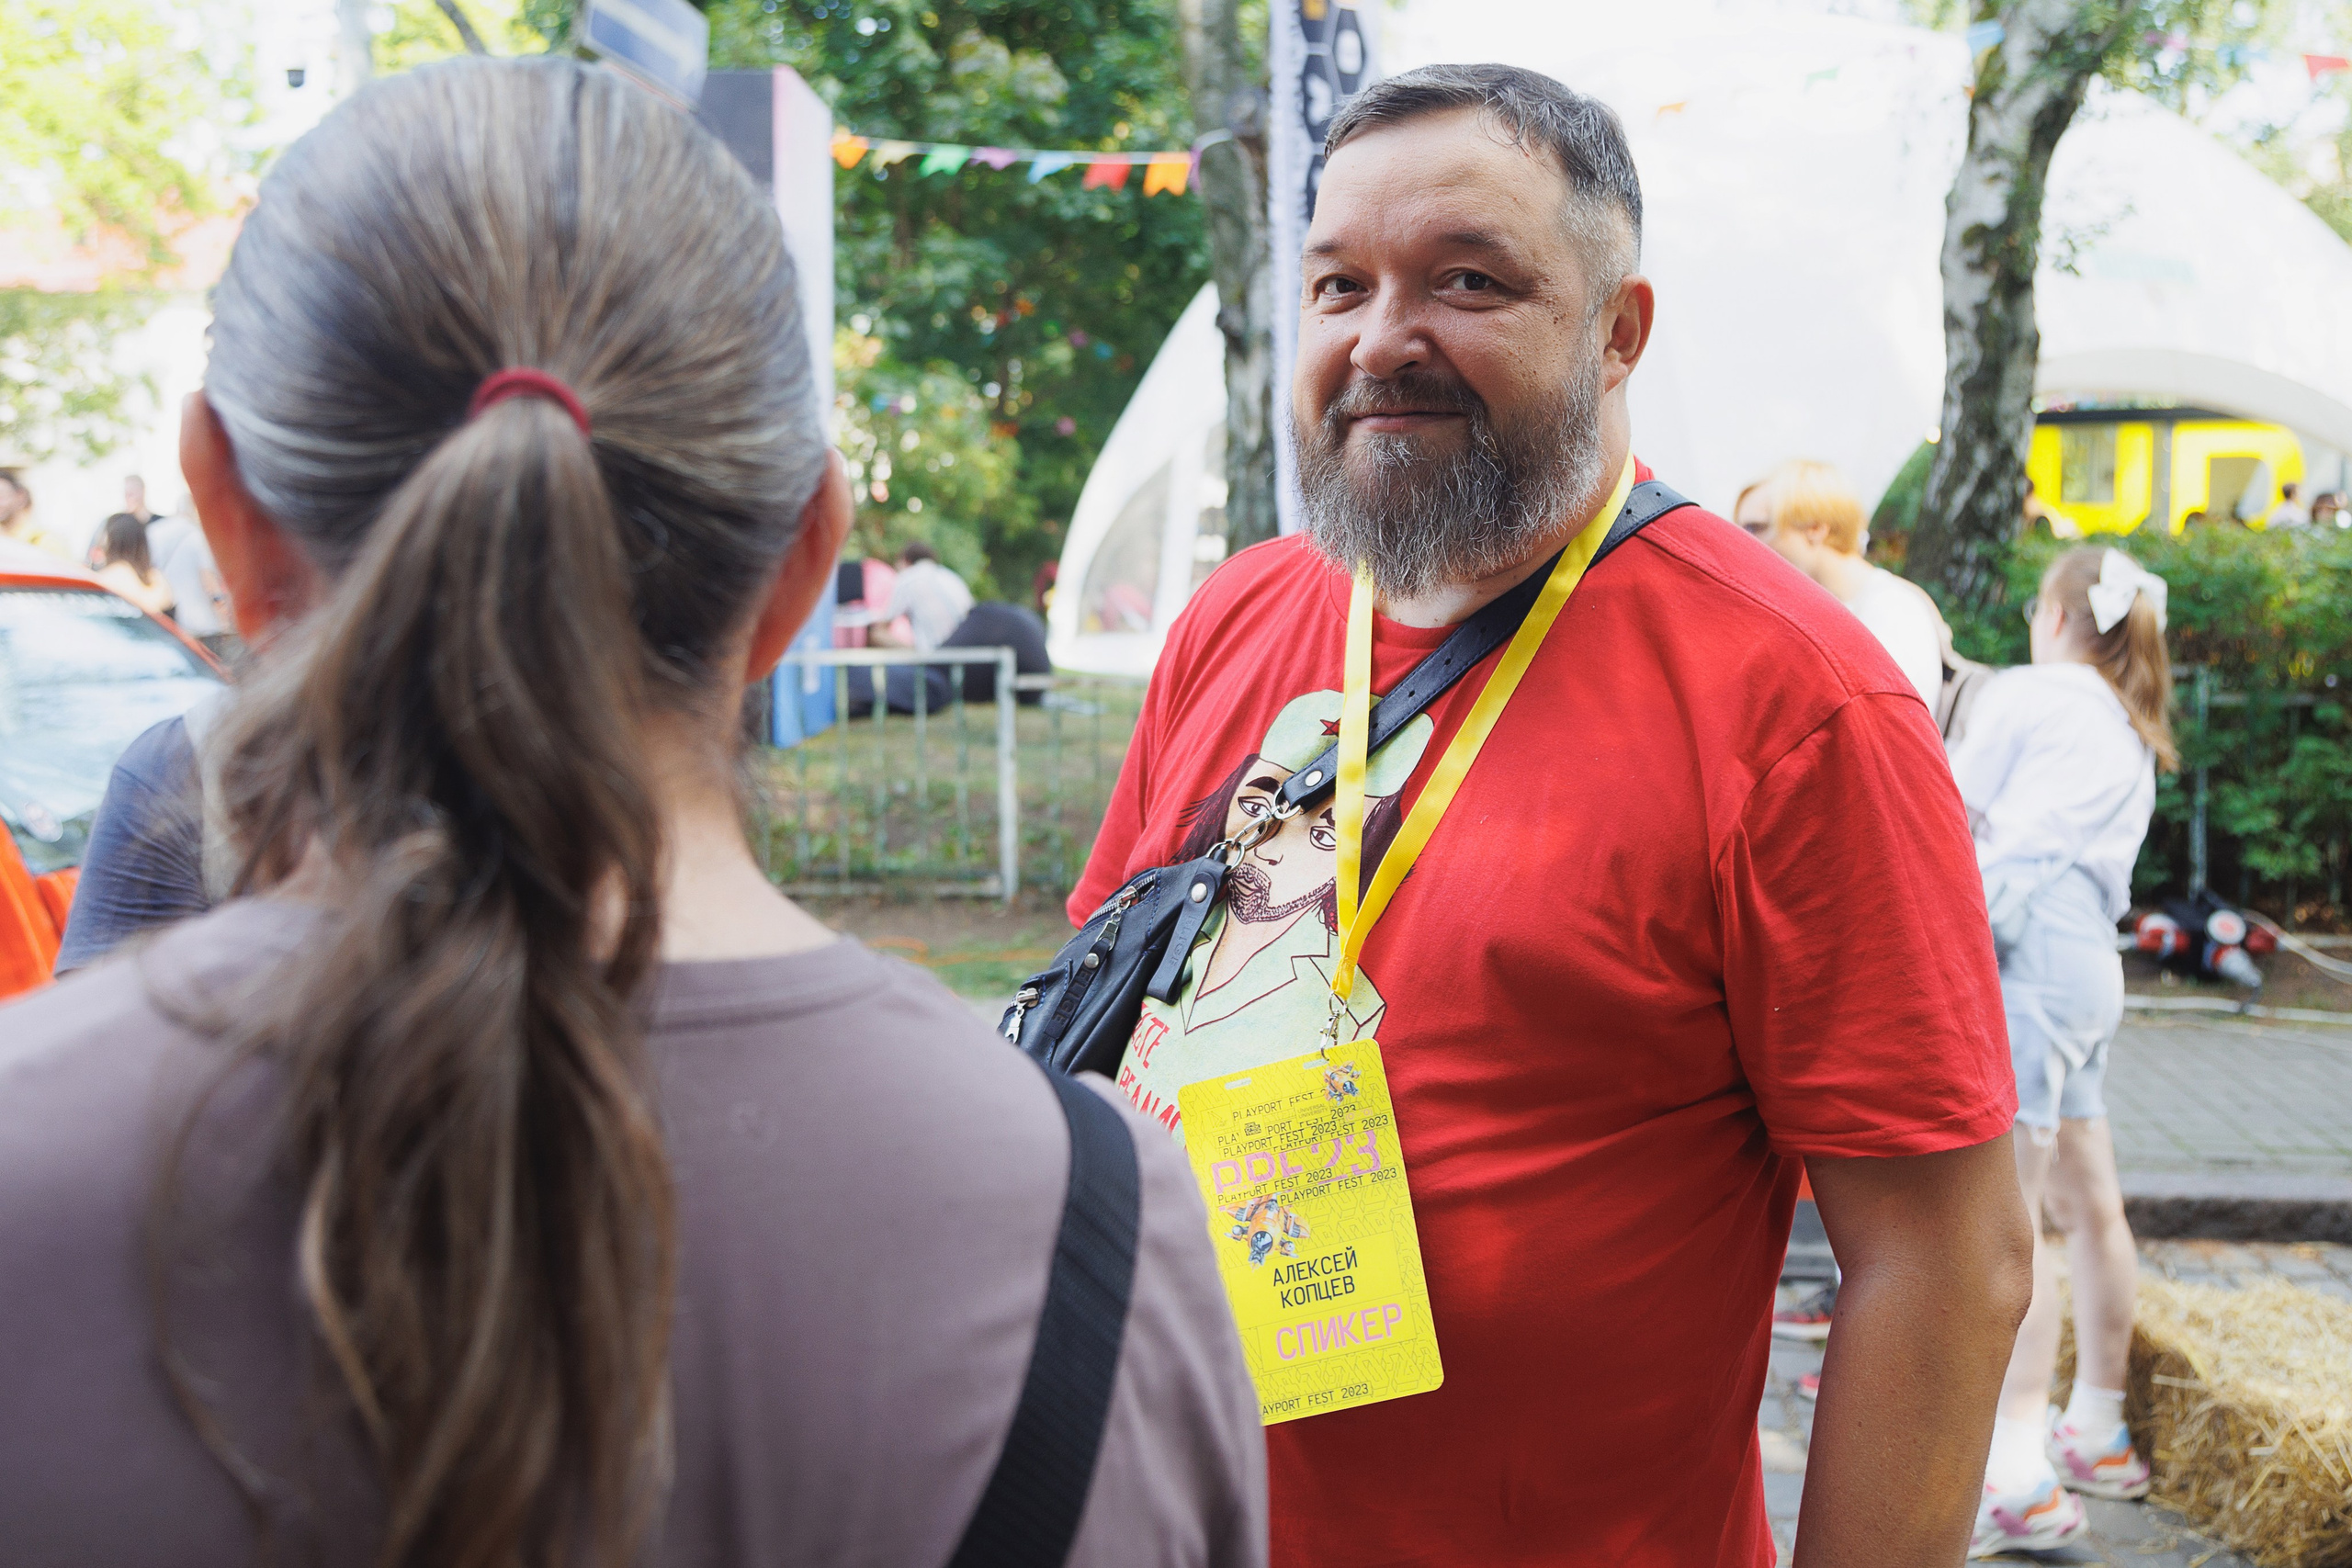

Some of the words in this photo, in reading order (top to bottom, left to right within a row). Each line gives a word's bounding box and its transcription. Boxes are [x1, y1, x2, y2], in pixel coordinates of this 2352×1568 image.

[1232, 1100, 1283, 1122] PLAYPORT
[1362, 1114, 1388, 1130] 2023
[1223, 1136, 1273, 1157] PLAYPORT
[1280, 1128, 1305, 1144] FEST
[1311, 1120, 1337, 1136] 2023
[1274, 1176, 1300, 1191] FEST
[1306, 1168, 1333, 1184] 2023
[1280, 1183, 1331, 1205] PLAYPORT
[1339, 1176, 1364, 1191] FEST
[1371, 1168, 1397, 1184] 2023
[1272, 1246, 1359, 1287] АЛЕКСЕЙ
[1280, 1275, 1356, 1309] КОПЦЕВ
[1275, 1303, 1403, 1361] СПИКЕР
[1260, 1398, 1302, 1416] AYPORT
[1308, 1390, 1335, 1406] FEST
[1341, 1383, 1369, 1399] 2023
